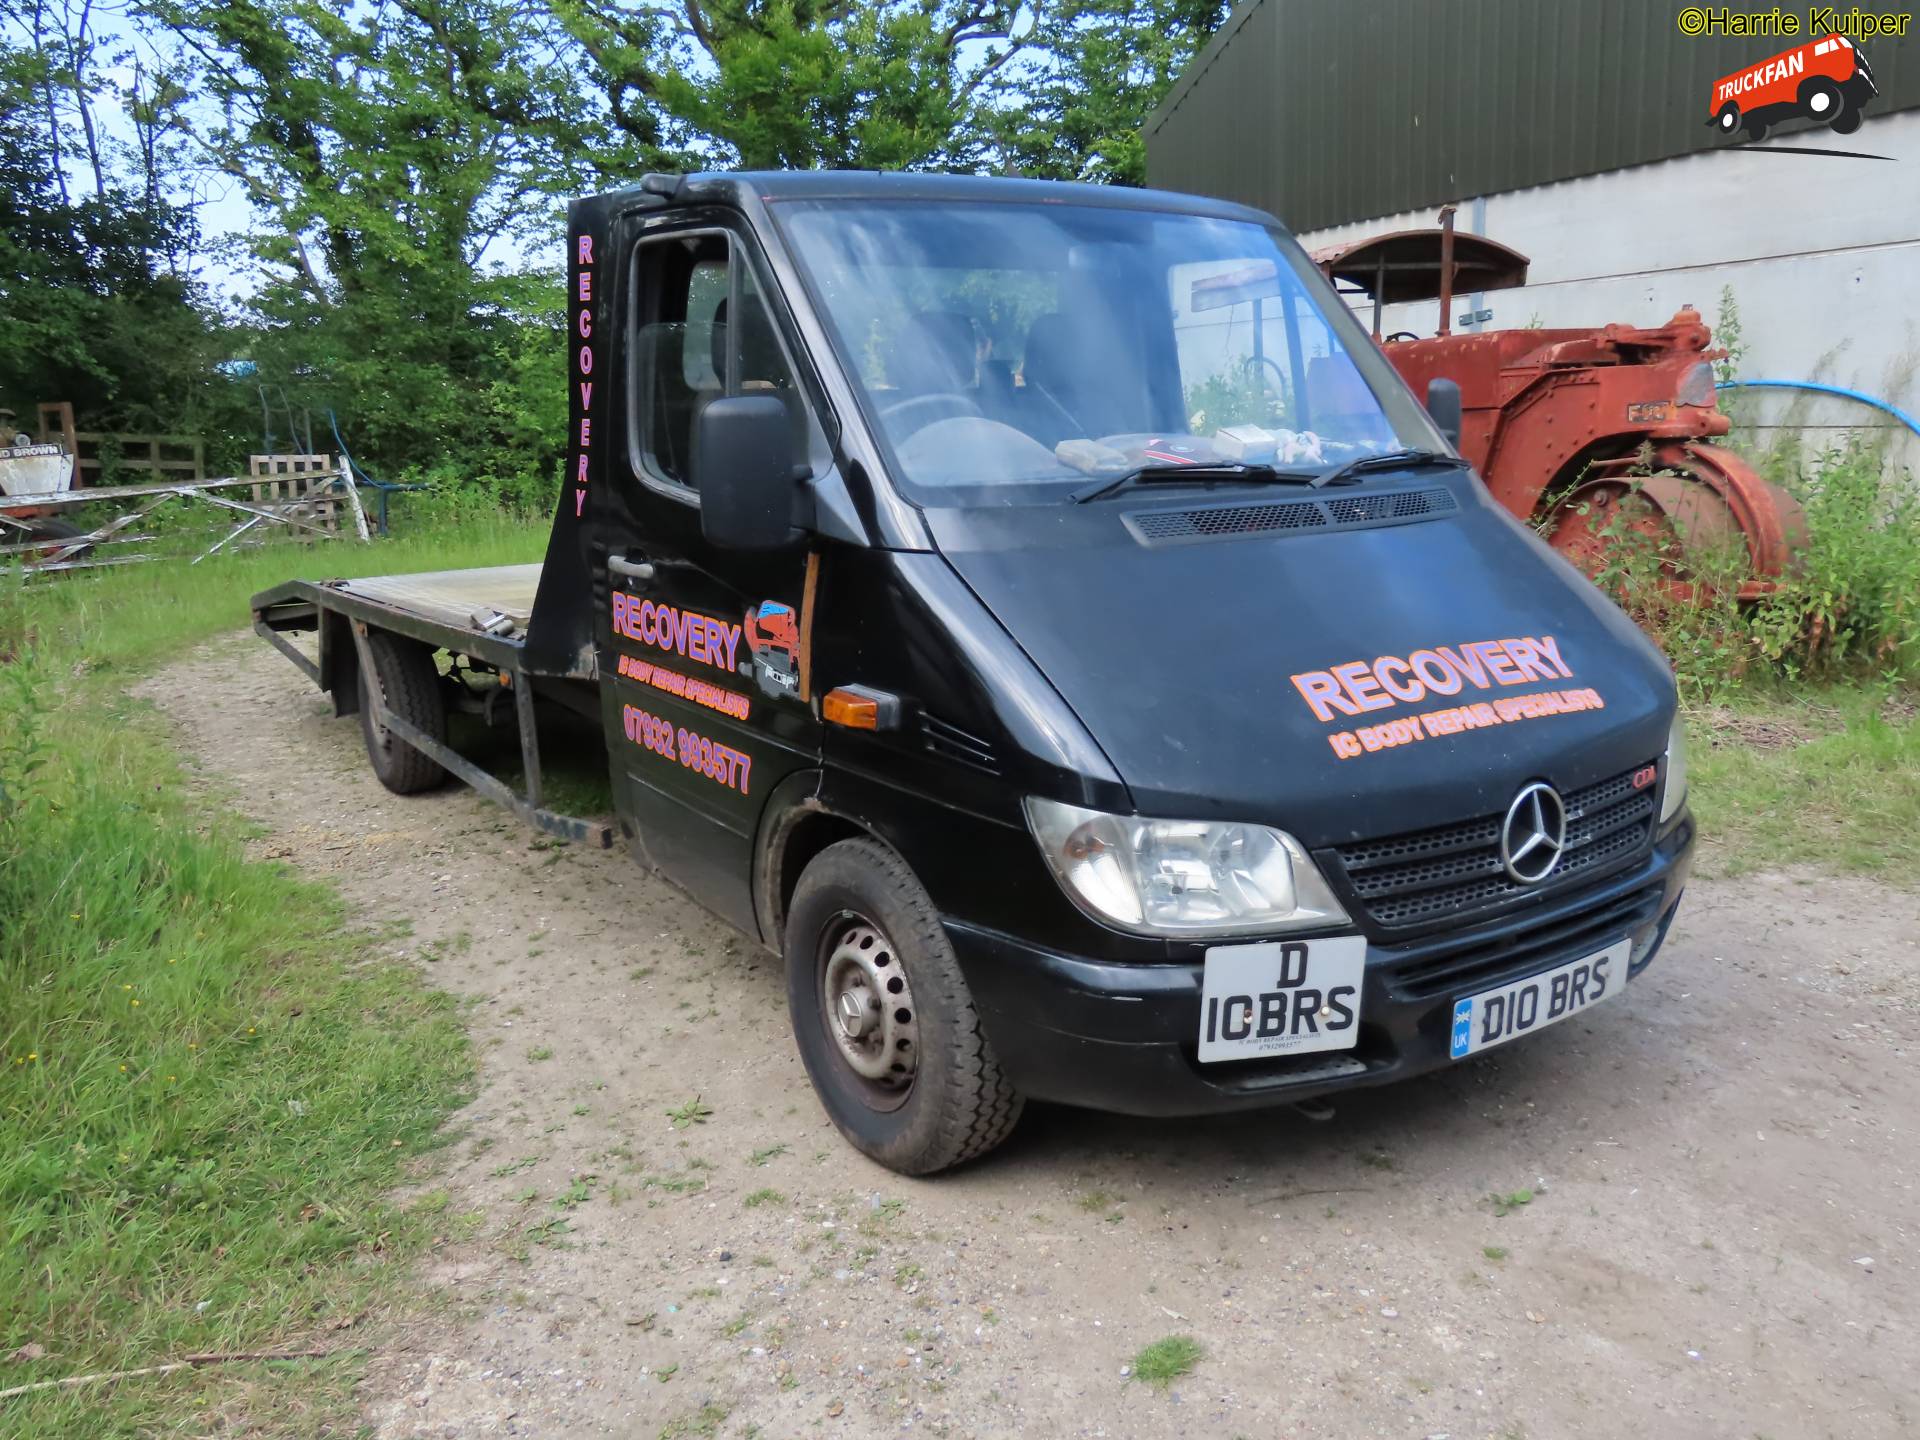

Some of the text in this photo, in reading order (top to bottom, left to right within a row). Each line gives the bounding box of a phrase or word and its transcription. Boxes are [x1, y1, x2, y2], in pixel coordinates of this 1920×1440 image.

[576, 235, 593, 517] RECOVERY
[13, 446, 58, 457] BROWN
[612, 591, 741, 672] RECOVERY
[627, 657, 654, 684] BODY
[651, 666, 686, 697] REPAIR
[684, 678, 750, 721] SPECIALISTS
[1290, 636, 1574, 722] RECOVERY
[623, 703, 751, 795] 07932 993577
[1328, 687, 1604, 760] IC BODY REPAIR SPECIALISTS
[1276, 942, 1309, 989] D
[1546, 956, 1610, 1020] BRS
[1454, 1031, 1468, 1049] UK
